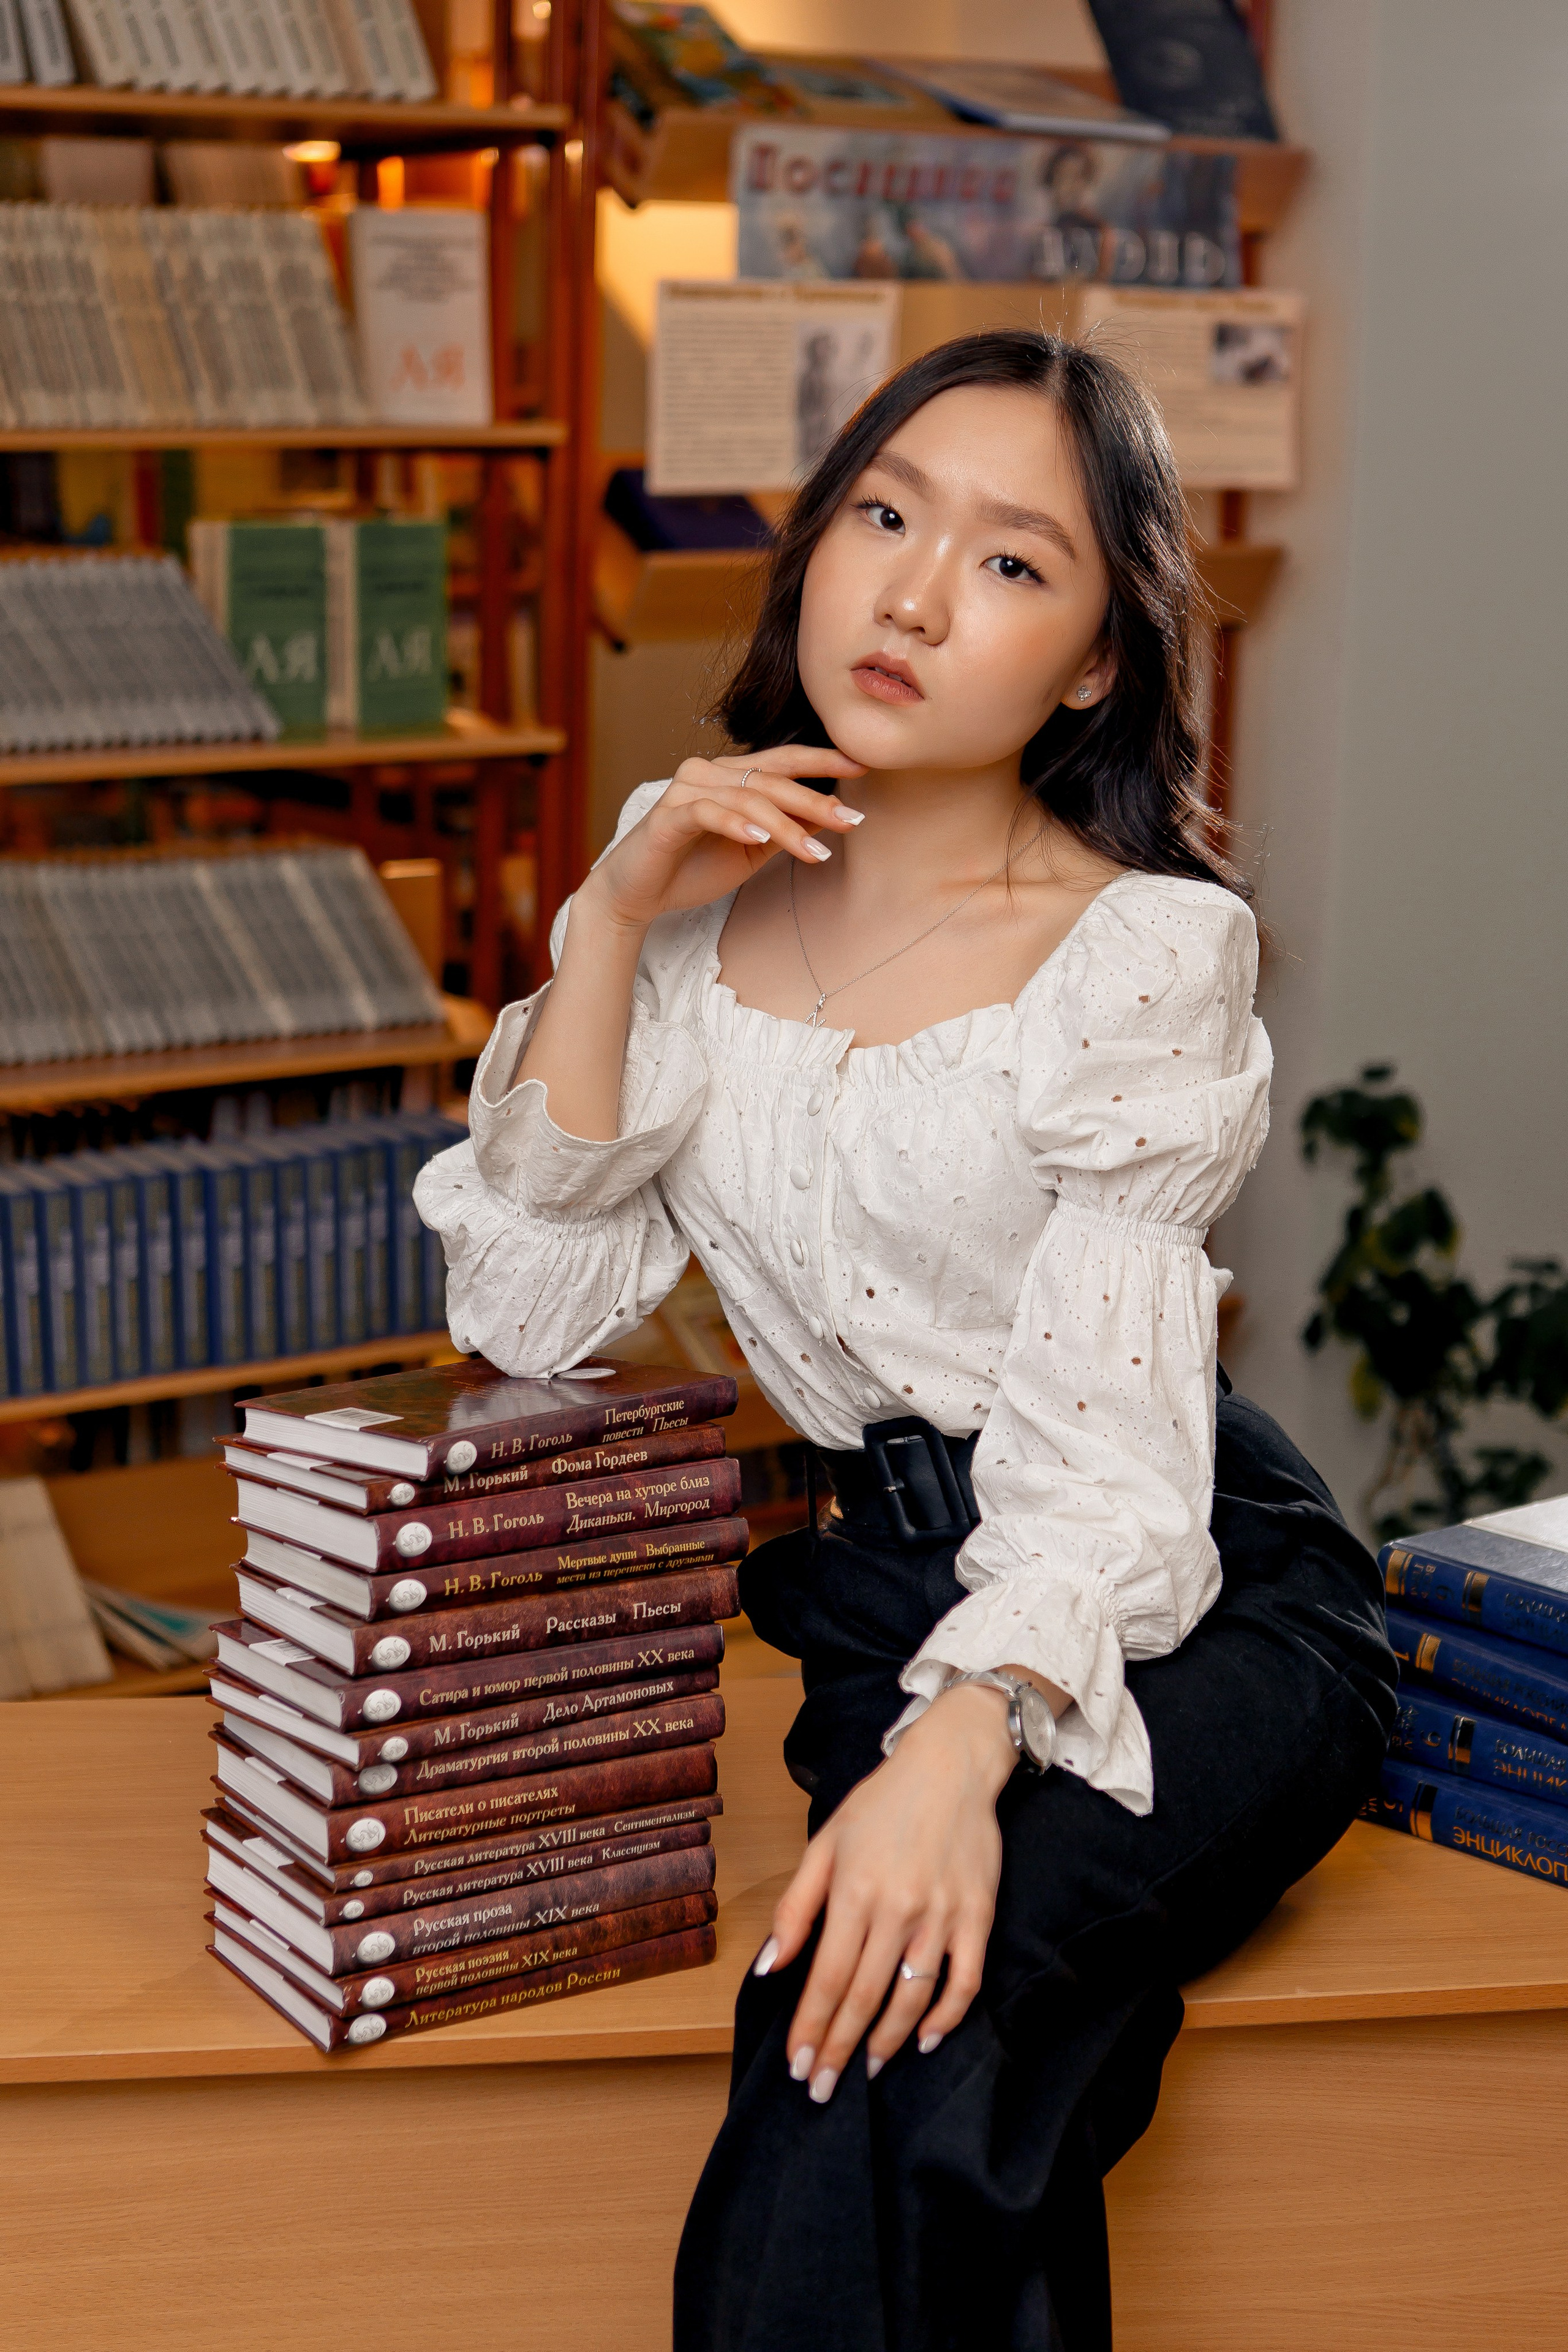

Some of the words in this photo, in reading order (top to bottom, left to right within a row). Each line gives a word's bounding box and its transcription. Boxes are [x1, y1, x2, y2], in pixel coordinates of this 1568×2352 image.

[602, 1425, 644, 1443] повести
[652, 1415, 688, 1431] Пьесы
[605, 1400, 684, 1424] Петербургские
[491, 1442, 508, 1459] Н.
[511, 1438, 527, 1453] В.
[529, 1433, 572, 1450] Гоголь
[444, 1477, 465, 1493] М.
[469, 1466, 528, 1489] Горький
[551, 1458, 592, 1474] Фома
[595, 1450, 647, 1469] Гордеев
[566, 1491, 613, 1509] Вечера
[617, 1489, 631, 1501] на
[635, 1483, 677, 1503] хуторе
[680, 1475, 710, 1490] близ
[449, 1521, 468, 1539] Н.
[473, 1517, 489, 1534] В.
[493, 1512, 544, 1531] Гоголь
[567, 1511, 636, 1533] Диканьки.
[644, 1498, 710, 1519] Миргород
[557, 1553, 606, 1570] Мертвые
[609, 1550, 637, 1563] души
[646, 1539, 705, 1557] Выбранные
[557, 1572, 586, 1585] места
[589, 1570, 601, 1578] из
[666, 1553, 714, 1569] друзьями
[445, 1578, 464, 1596] Н.
[469, 1575, 486, 1591] В.
[490, 1570, 543, 1589] Гоголь
[429, 1635, 452, 1653] М.
[457, 1624, 520, 1649] Горький
[546, 1611, 616, 1633] Рассказы
[633, 1602, 681, 1620] Пьесы
[420, 1687, 469, 1705] Сатира
[472, 1687, 480, 1696] и
[484, 1680, 520, 1695] юмор
[524, 1667, 568, 1688] первой
[571, 1660, 634, 1679] половины
[637, 1648, 664, 1667] XX
[668, 1648, 694, 1662] века
[434, 1726, 456, 1747] М.
[460, 1712, 518, 1741] Горький
[543, 1702, 578, 1723] Дело
[582, 1681, 674, 1713] Артамоновых
[417, 1751, 509, 1781] Драматургия
[513, 1737, 559, 1760] второй
[564, 1727, 630, 1751] половины
[633, 1719, 661, 1738] XX
[665, 1717, 694, 1732] века
[404, 1801, 473, 1825] Писатели
[478, 1800, 486, 1811] о
[490, 1786, 559, 1809] писателях
[404, 1815, 507, 1844] Литературные
[510, 1804, 575, 1824] портреты
[414, 1855, 464, 1874] Русская
[467, 1841, 535, 1864] литература
[538, 1828, 576, 1849] XVIII
[579, 1825, 605, 1839] века
[614, 1809, 695, 1833] Сентиментализм
[403, 1885, 453, 1905] Русская
[456, 1870, 523, 1894] литература
[527, 1856, 564, 1877] XVIII
[568, 1854, 593, 1868] века
[602, 1841, 660, 1860] Классицизм
[412, 1932, 461, 1955] второй
[464, 1919, 530, 1943] половины
[533, 1907, 567, 1927] XIX
[571, 1902, 600, 1917] века
[413, 1915, 470, 1937] Русская
[473, 1902, 513, 1924] проза
[415, 1963, 466, 1983] Русская
[468, 1950, 510, 1968] поэзия
[415, 1975, 458, 1996] первой
[460, 1963, 519, 1983] половины
[521, 1950, 550, 1969] XIX
[552, 1946, 578, 1960] века
[405, 1997, 497, 2028] Литература
[501, 1983, 562, 2006] народов
[567, 1967, 621, 1990] России
